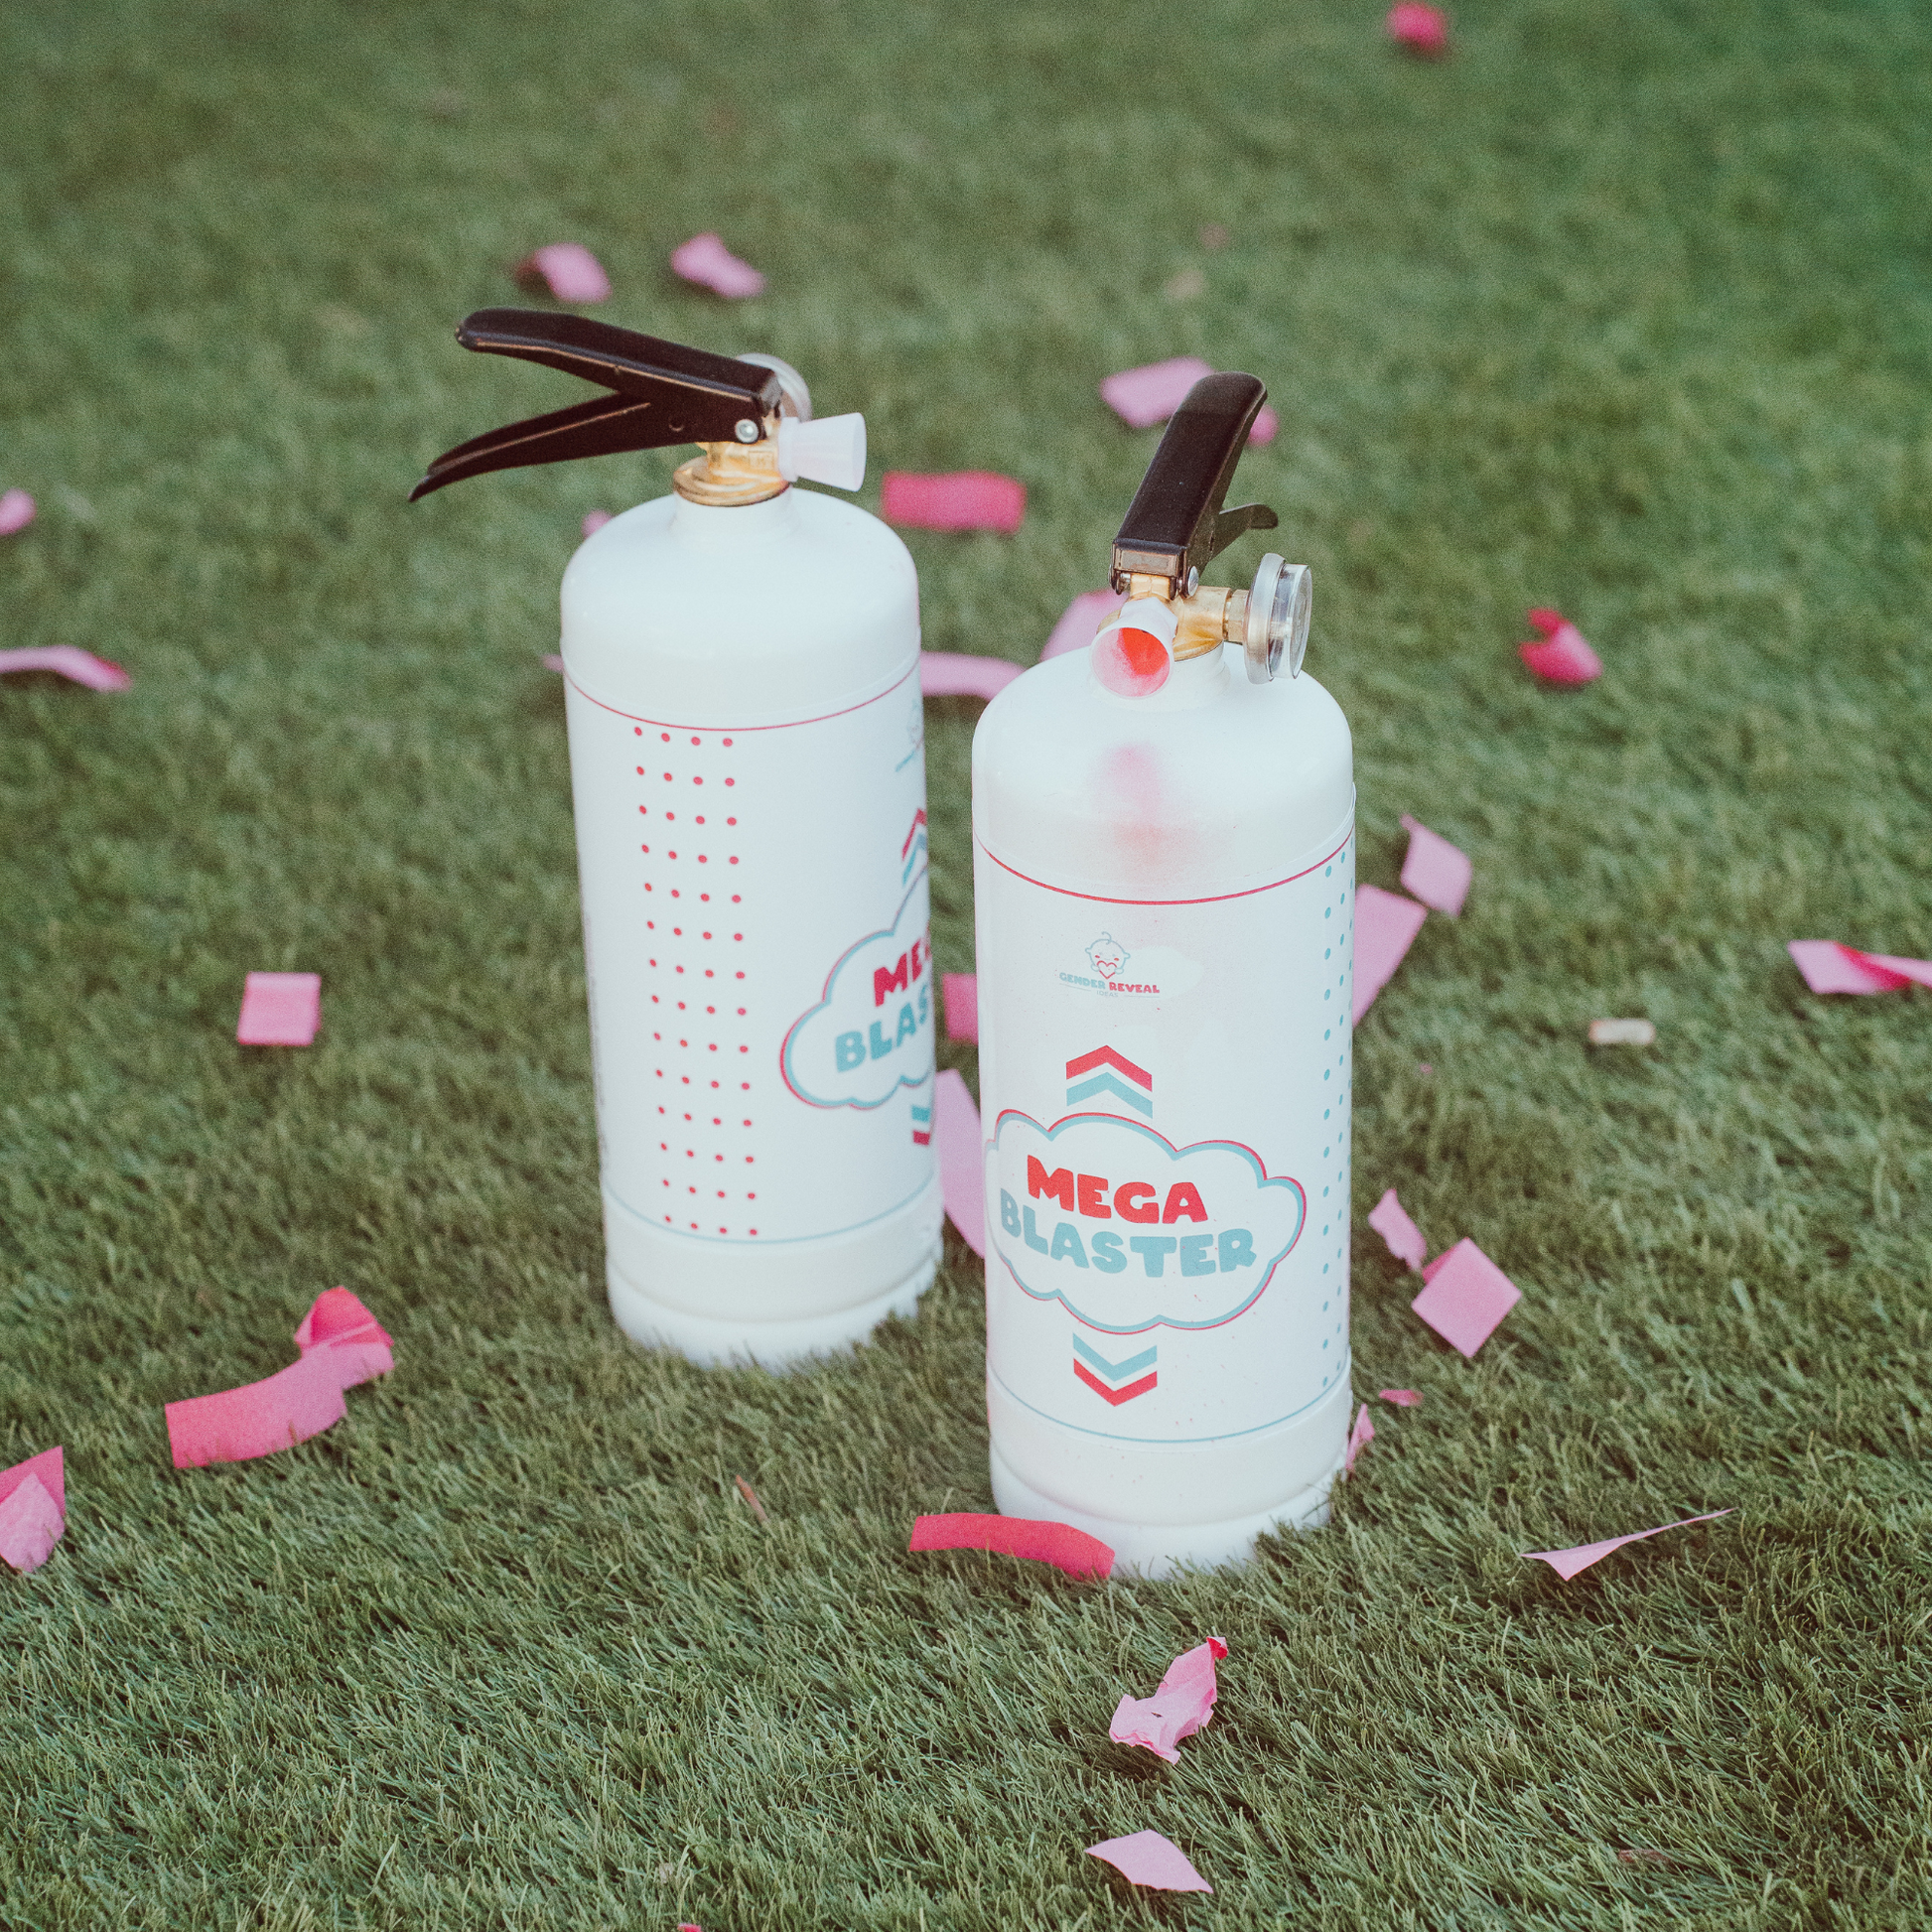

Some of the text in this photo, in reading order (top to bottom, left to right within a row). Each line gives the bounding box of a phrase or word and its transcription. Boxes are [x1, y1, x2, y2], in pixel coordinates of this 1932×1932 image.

[1058, 972, 1161, 994] GENDER REVEAL
[1027, 1154, 1209, 1225] MEGA
[1000, 1187, 1258, 1278] BLASTER
